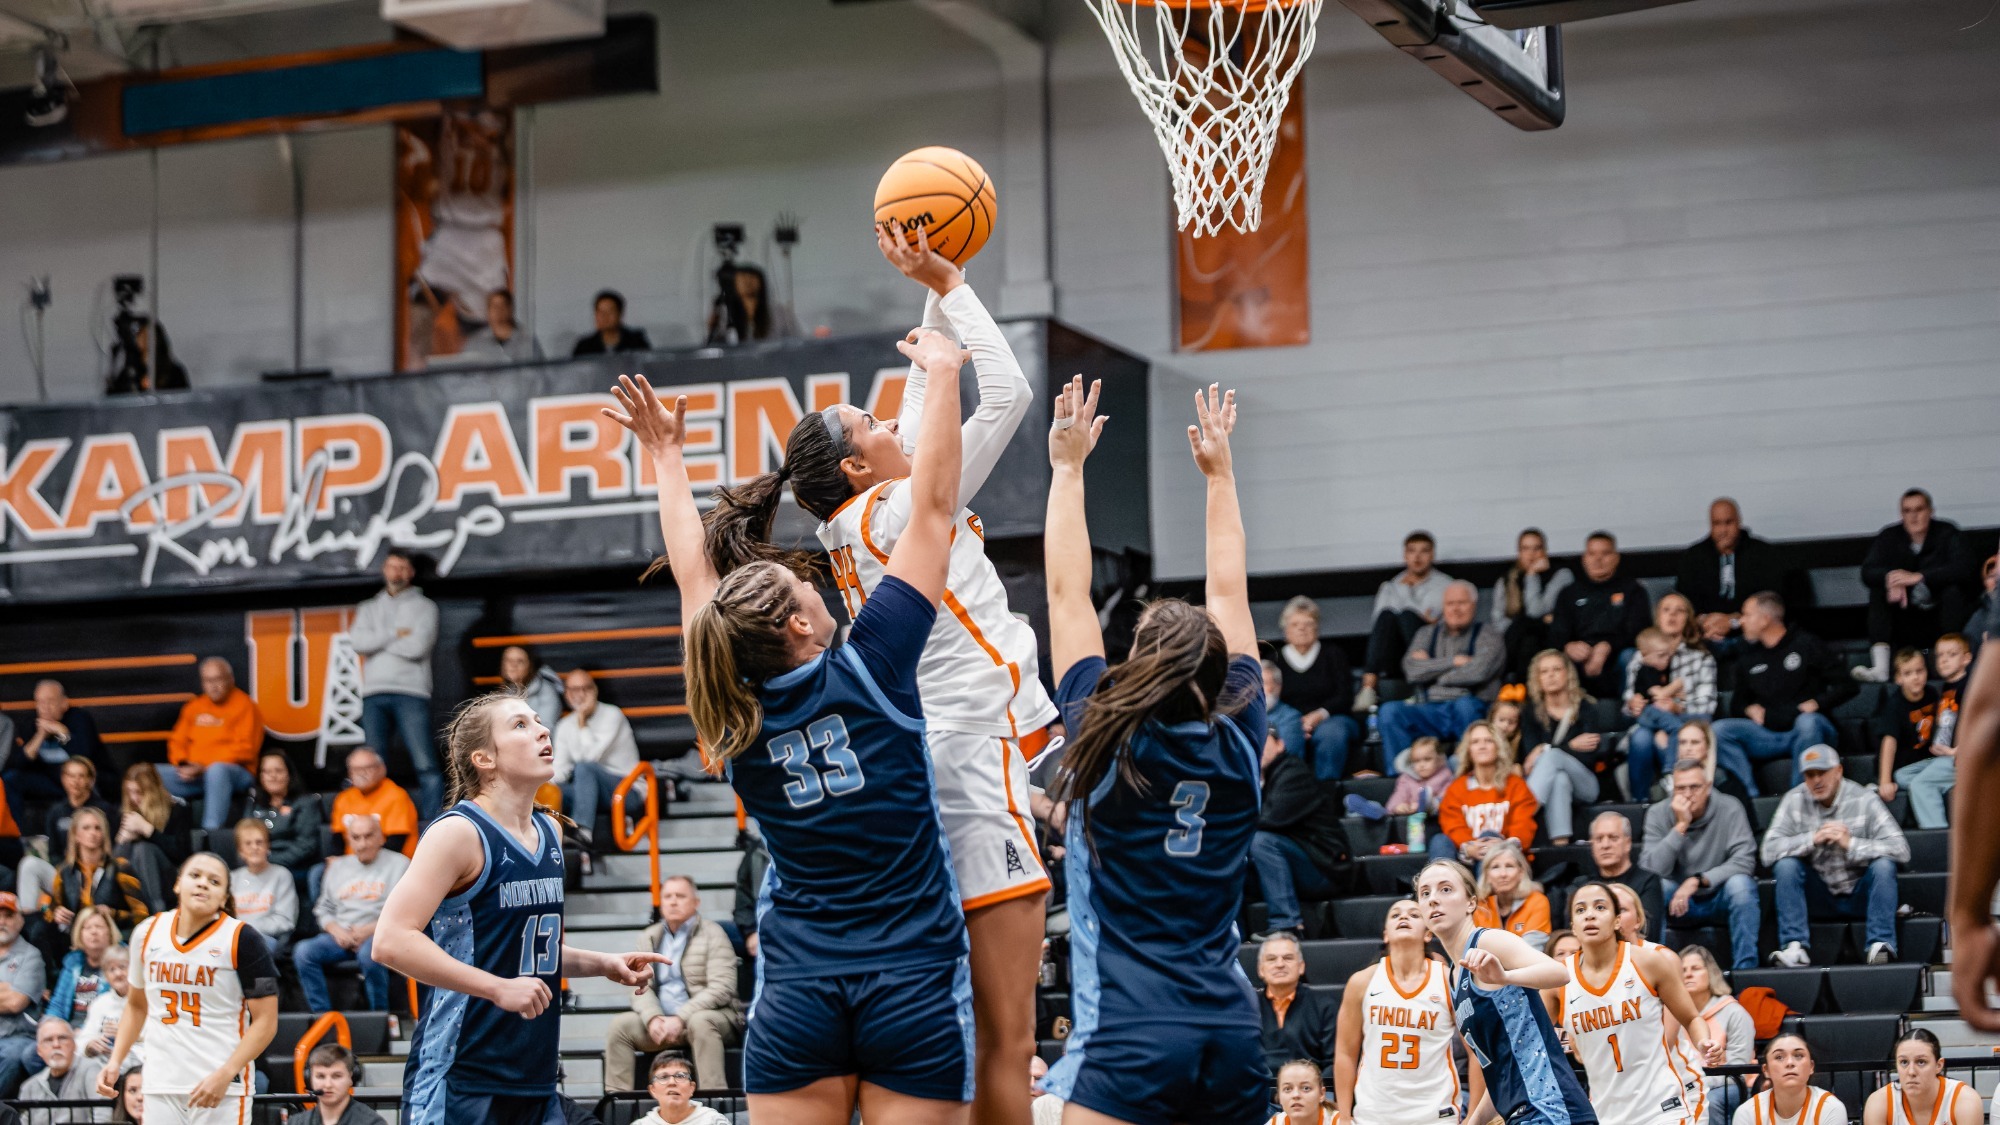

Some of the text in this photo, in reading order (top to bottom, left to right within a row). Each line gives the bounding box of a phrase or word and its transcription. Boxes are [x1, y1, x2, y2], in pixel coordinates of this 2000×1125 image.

[434, 366, 912, 511] AREN
[766, 713, 865, 809] 33
[1164, 781, 1211, 857] 3
[519, 913, 561, 976] 13
[149, 961, 218, 987] FINDLAY
[160, 989, 200, 1027] 34
[1370, 1005, 1440, 1030] FINDLAY
[1571, 996, 1642, 1034] FINDLAY
[1381, 1032, 1421, 1069] 23
[1607, 1033, 1623, 1073] 1
